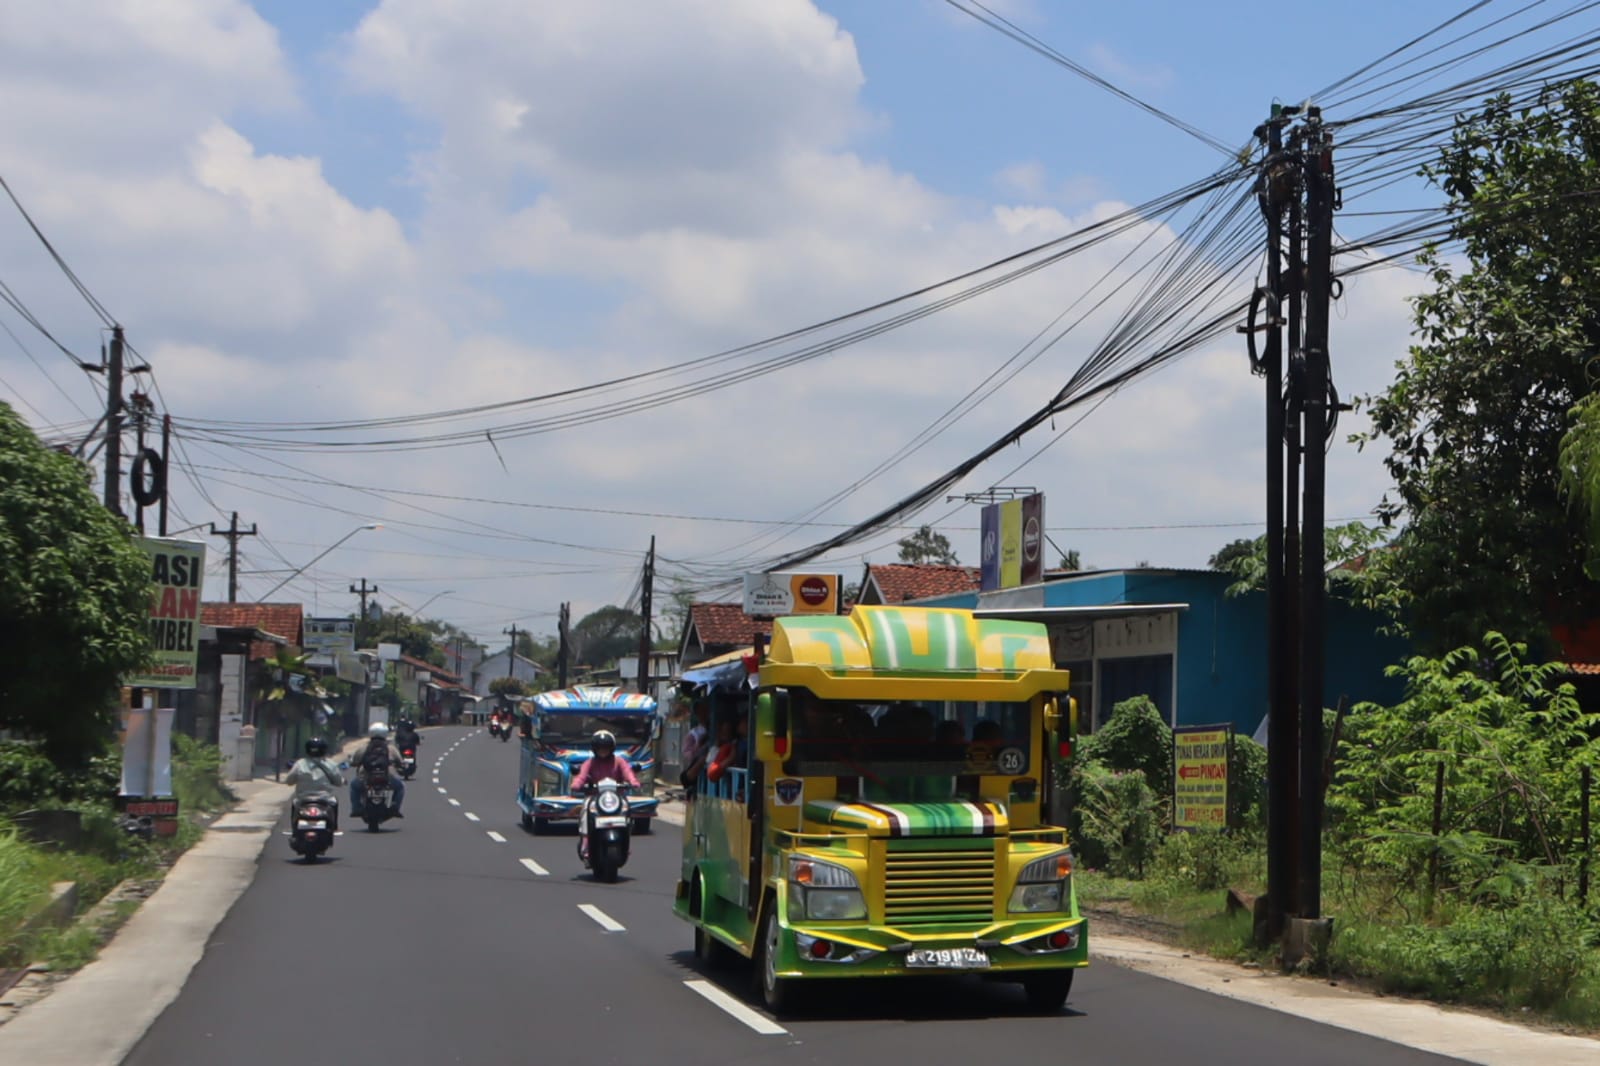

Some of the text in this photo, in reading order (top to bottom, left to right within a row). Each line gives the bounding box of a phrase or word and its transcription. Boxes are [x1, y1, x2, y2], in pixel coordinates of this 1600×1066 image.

[151, 553, 199, 587] ASI
[151, 620, 194, 651] MBEL
[1006, 754, 1018, 768] 26
